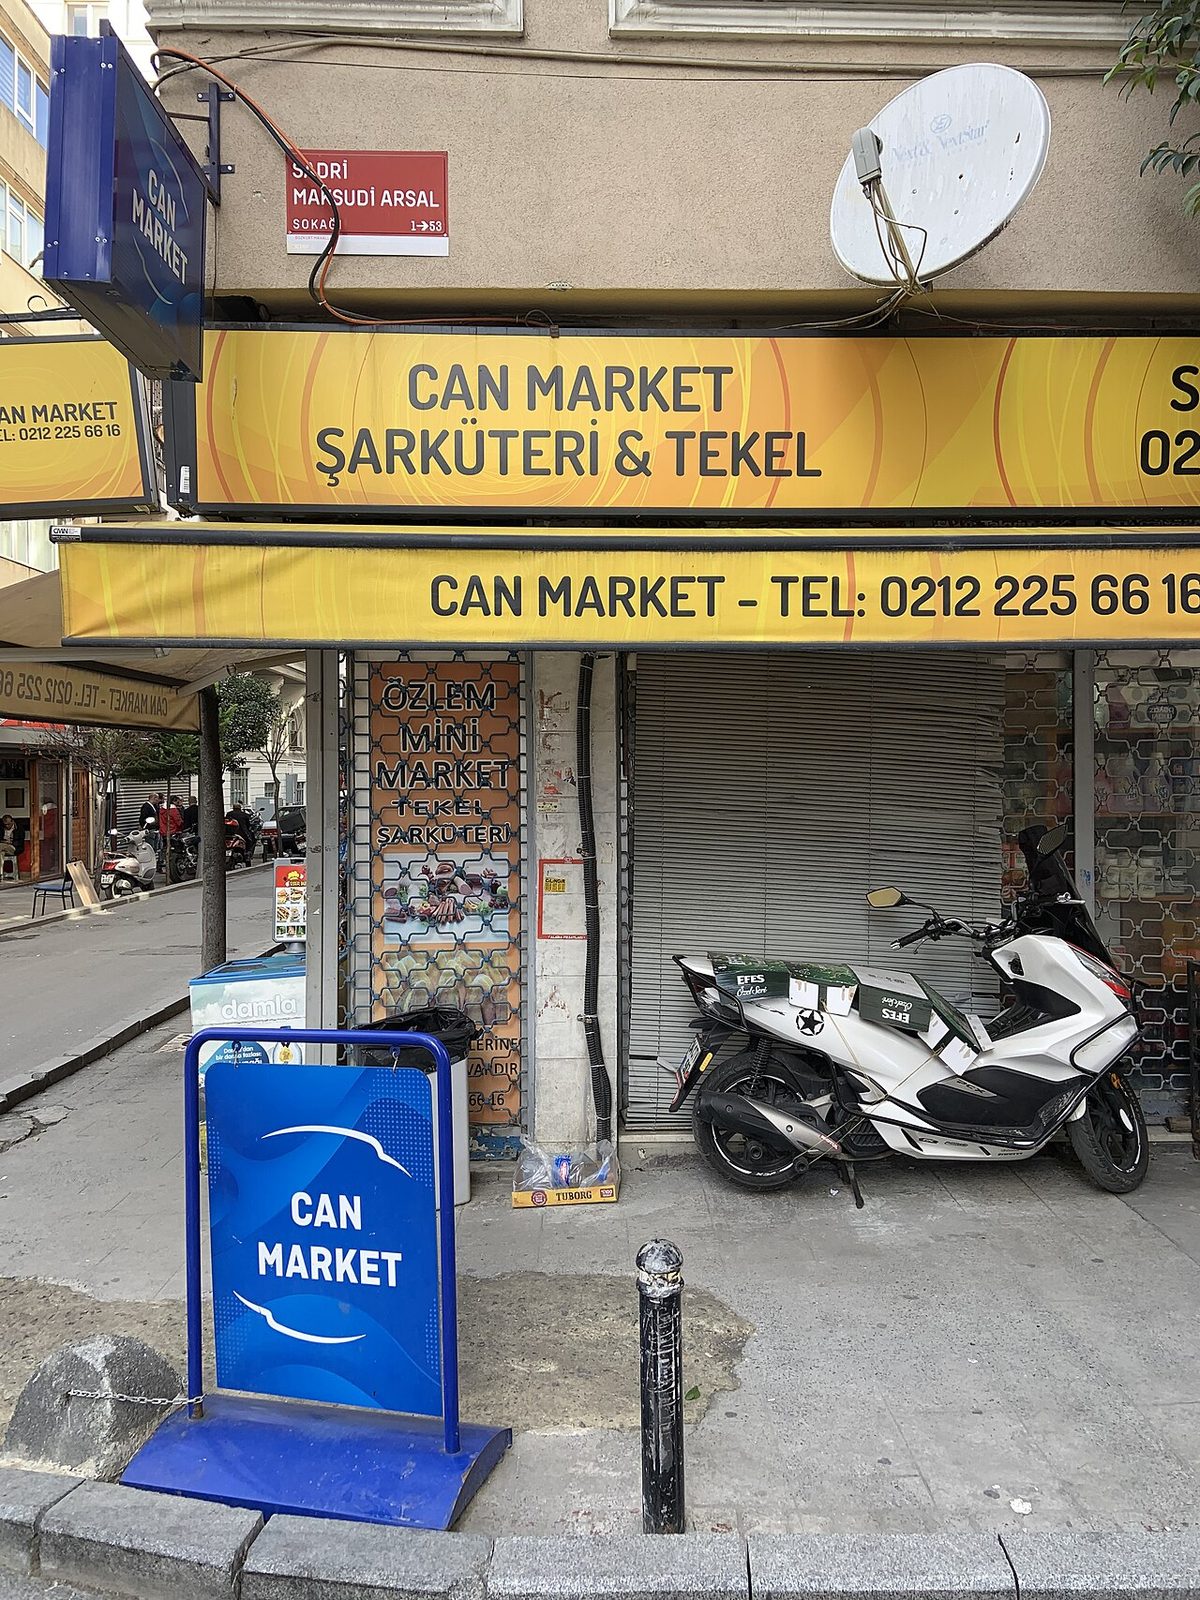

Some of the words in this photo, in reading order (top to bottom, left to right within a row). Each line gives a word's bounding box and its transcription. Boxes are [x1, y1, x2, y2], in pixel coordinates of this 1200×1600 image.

[292, 160, 348, 180] SDRİ
[148, 169, 176, 233] CAN
[381, 190, 440, 208] ARSAL
[132, 188, 188, 285] MARKET
[408, 364, 509, 412] CAN
[528, 365, 734, 413] MARKET
[32, 402, 118, 423] MARKET
[19, 428, 52, 441] 0212
[54, 426, 81, 439] 225
[84, 425, 103, 437] 66
[105, 424, 121, 436] 16
[315, 417, 599, 487] ŞARKÜTERİ
[614, 430, 652, 477] &
[666, 431, 823, 477] TEKEL
[1140, 430, 1200, 476] 02
[430, 575, 522, 617] CAN
[538, 575, 726, 618] MARKET
[771, 576, 867, 618] TEL:
[880, 576, 981, 617] 0212
[993, 574, 1077, 616] 225
[1090, 574, 1150, 616] 66
[1161, 573, 1200, 614] 16
[382, 677, 497, 712] ÖZLEM
[400, 717, 479, 752] MİNİ
[376, 759, 511, 789] MARKET
[391, 799, 490, 817] TEKEL
[736, 974, 766, 985] EFES
[221, 993, 297, 1020] damla
[881, 1007, 910, 1024] EFES
[491, 1093, 505, 1106] 16
[956, 1079, 986, 1094] PCX
[556, 1191, 592, 1201] TUBORG
[291, 1192, 362, 1230] CAN
[257, 1241, 402, 1287] MARKET
